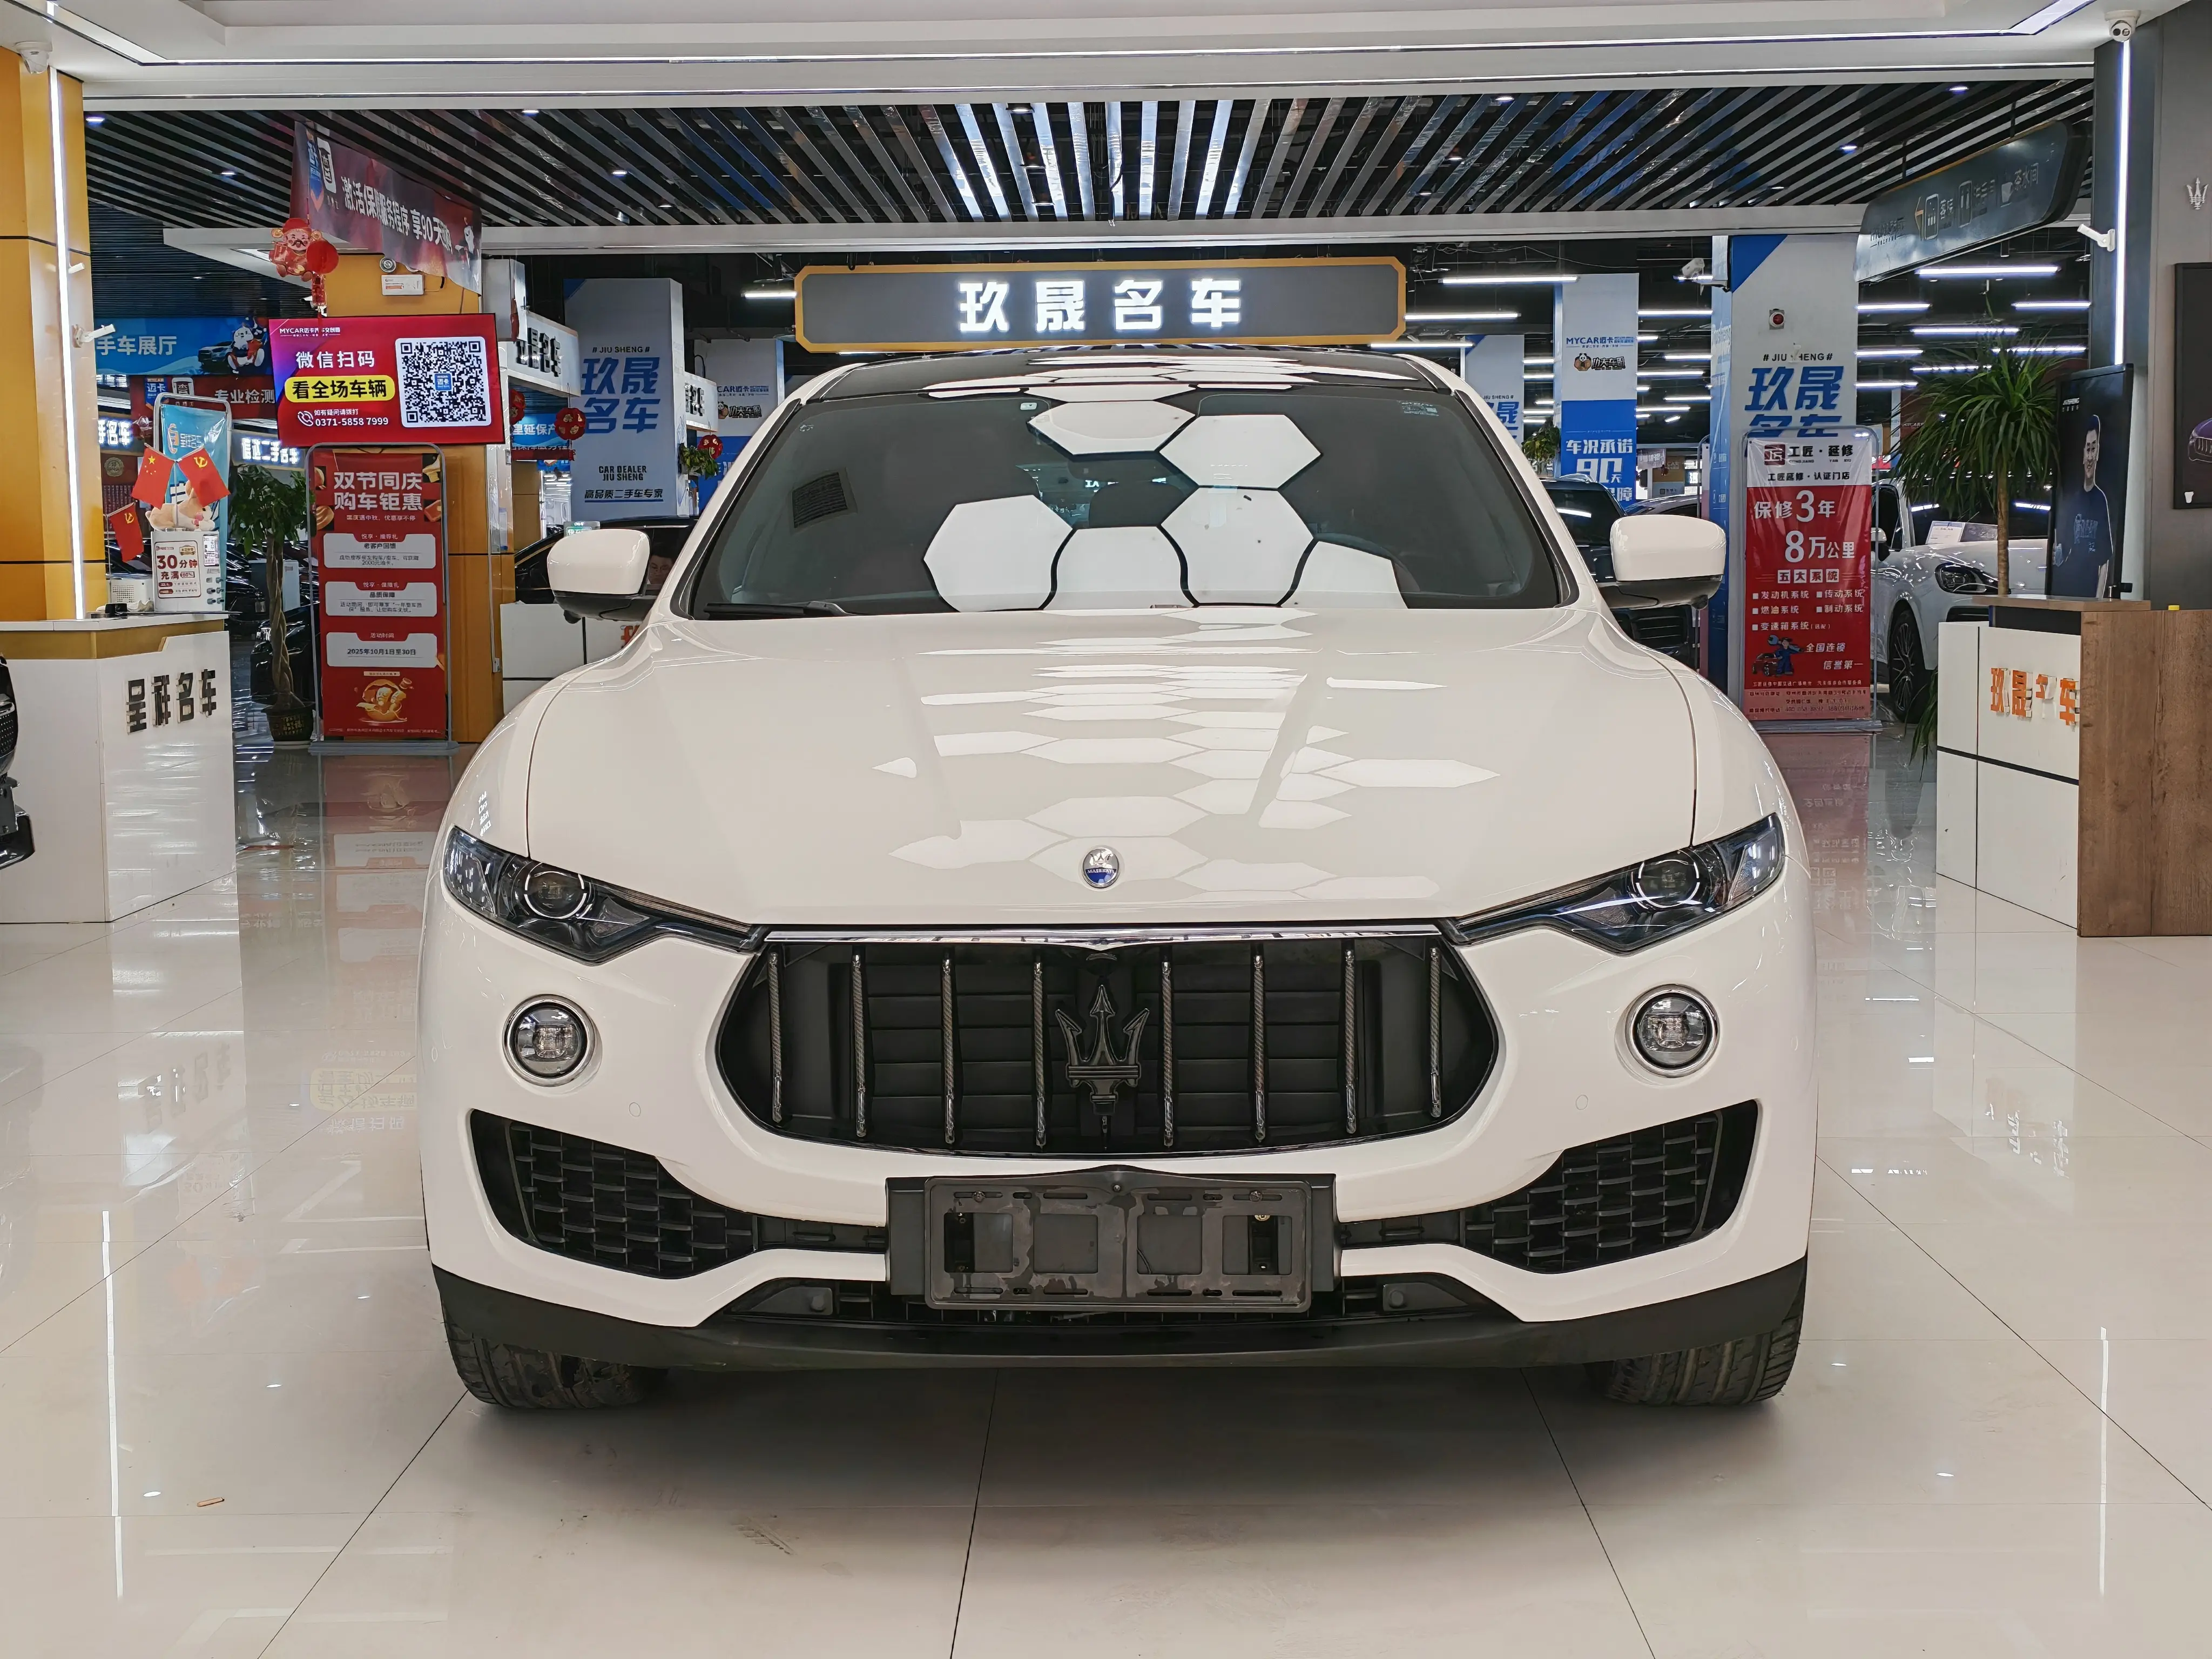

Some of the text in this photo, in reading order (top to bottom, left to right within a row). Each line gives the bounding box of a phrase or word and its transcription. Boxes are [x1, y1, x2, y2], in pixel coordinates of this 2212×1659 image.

[959, 279, 1240, 332] 玖晟名车
[97, 335, 177, 356] 手车展厅
[295, 350, 375, 369] 微信扫码
[1771, 353, 1787, 362] JIU
[1790, 353, 1825, 361] HENG
[581, 357, 660, 395] 玖晟
[146, 383, 166, 393] 迈卡
[215, 388, 275, 404] 专业检测
[292, 379, 387, 400] 看全场车辆
[1744, 366, 1844, 411] 玖晟
[314, 408, 359, 416] 如有疑问请拨打
[584, 397, 661, 434] 名车
[315, 416, 389, 427] 0371-5858 7999
[1566, 438, 1634, 455] 车况承诺
[598, 465, 647, 474] CAR DEALER
[602, 473, 644, 481] JIU SHENG
[334, 471, 423, 490] 双节同庆
[334, 492, 423, 511] 购车钜惠
[584, 488, 664, 500] 高品质二手车专家
[1754, 490, 1836, 523] 保修3年
[1784, 530, 1855, 563] 8万公里
[160, 571, 179, 580] 充满
[1778, 570, 1839, 583] 五大系统
[1761, 589, 1864, 600] 发动机系统 传动系统
[1760, 604, 1864, 615] 燃油系统 制动系统
[1805, 642, 1846, 653] 全国连锁
[1823, 660, 1864, 670] 信誉第一
[127, 669, 217, 734] 呈祥名车
